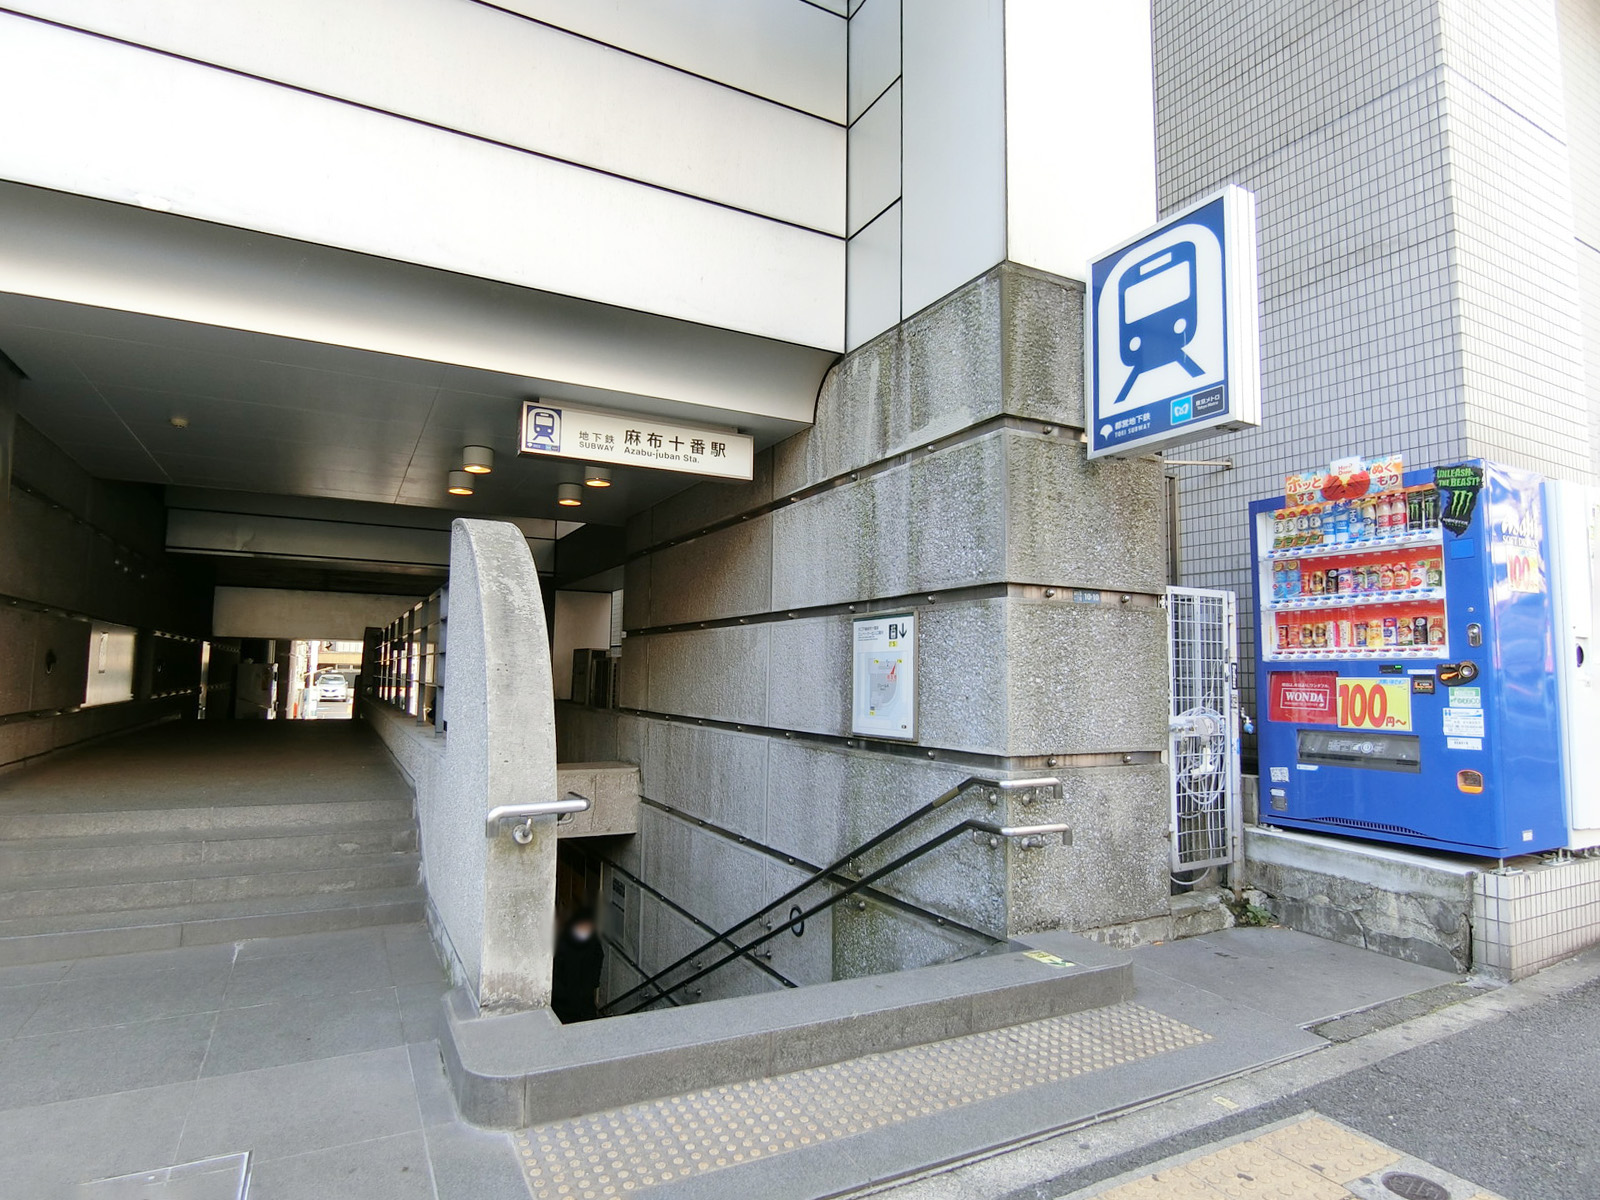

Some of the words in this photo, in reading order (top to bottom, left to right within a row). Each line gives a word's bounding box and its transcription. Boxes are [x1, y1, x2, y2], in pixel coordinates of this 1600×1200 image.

[1128, 422, 1151, 434] SUBWAY
[578, 430, 615, 445] 地下鉄
[624, 429, 726, 458] 麻布十番駅
[579, 441, 615, 452] SUBWAY
[623, 446, 681, 460] Azabu-juban
[683, 454, 700, 463] Sta.
[1371, 461, 1394, 475] ぬく
[1437, 468, 1472, 478] UNLEASH
[1287, 476, 1323, 493] ホッと
[1376, 474, 1399, 487] もり
[1297, 492, 1315, 502] する
[1285, 691, 1324, 703] WONDA
